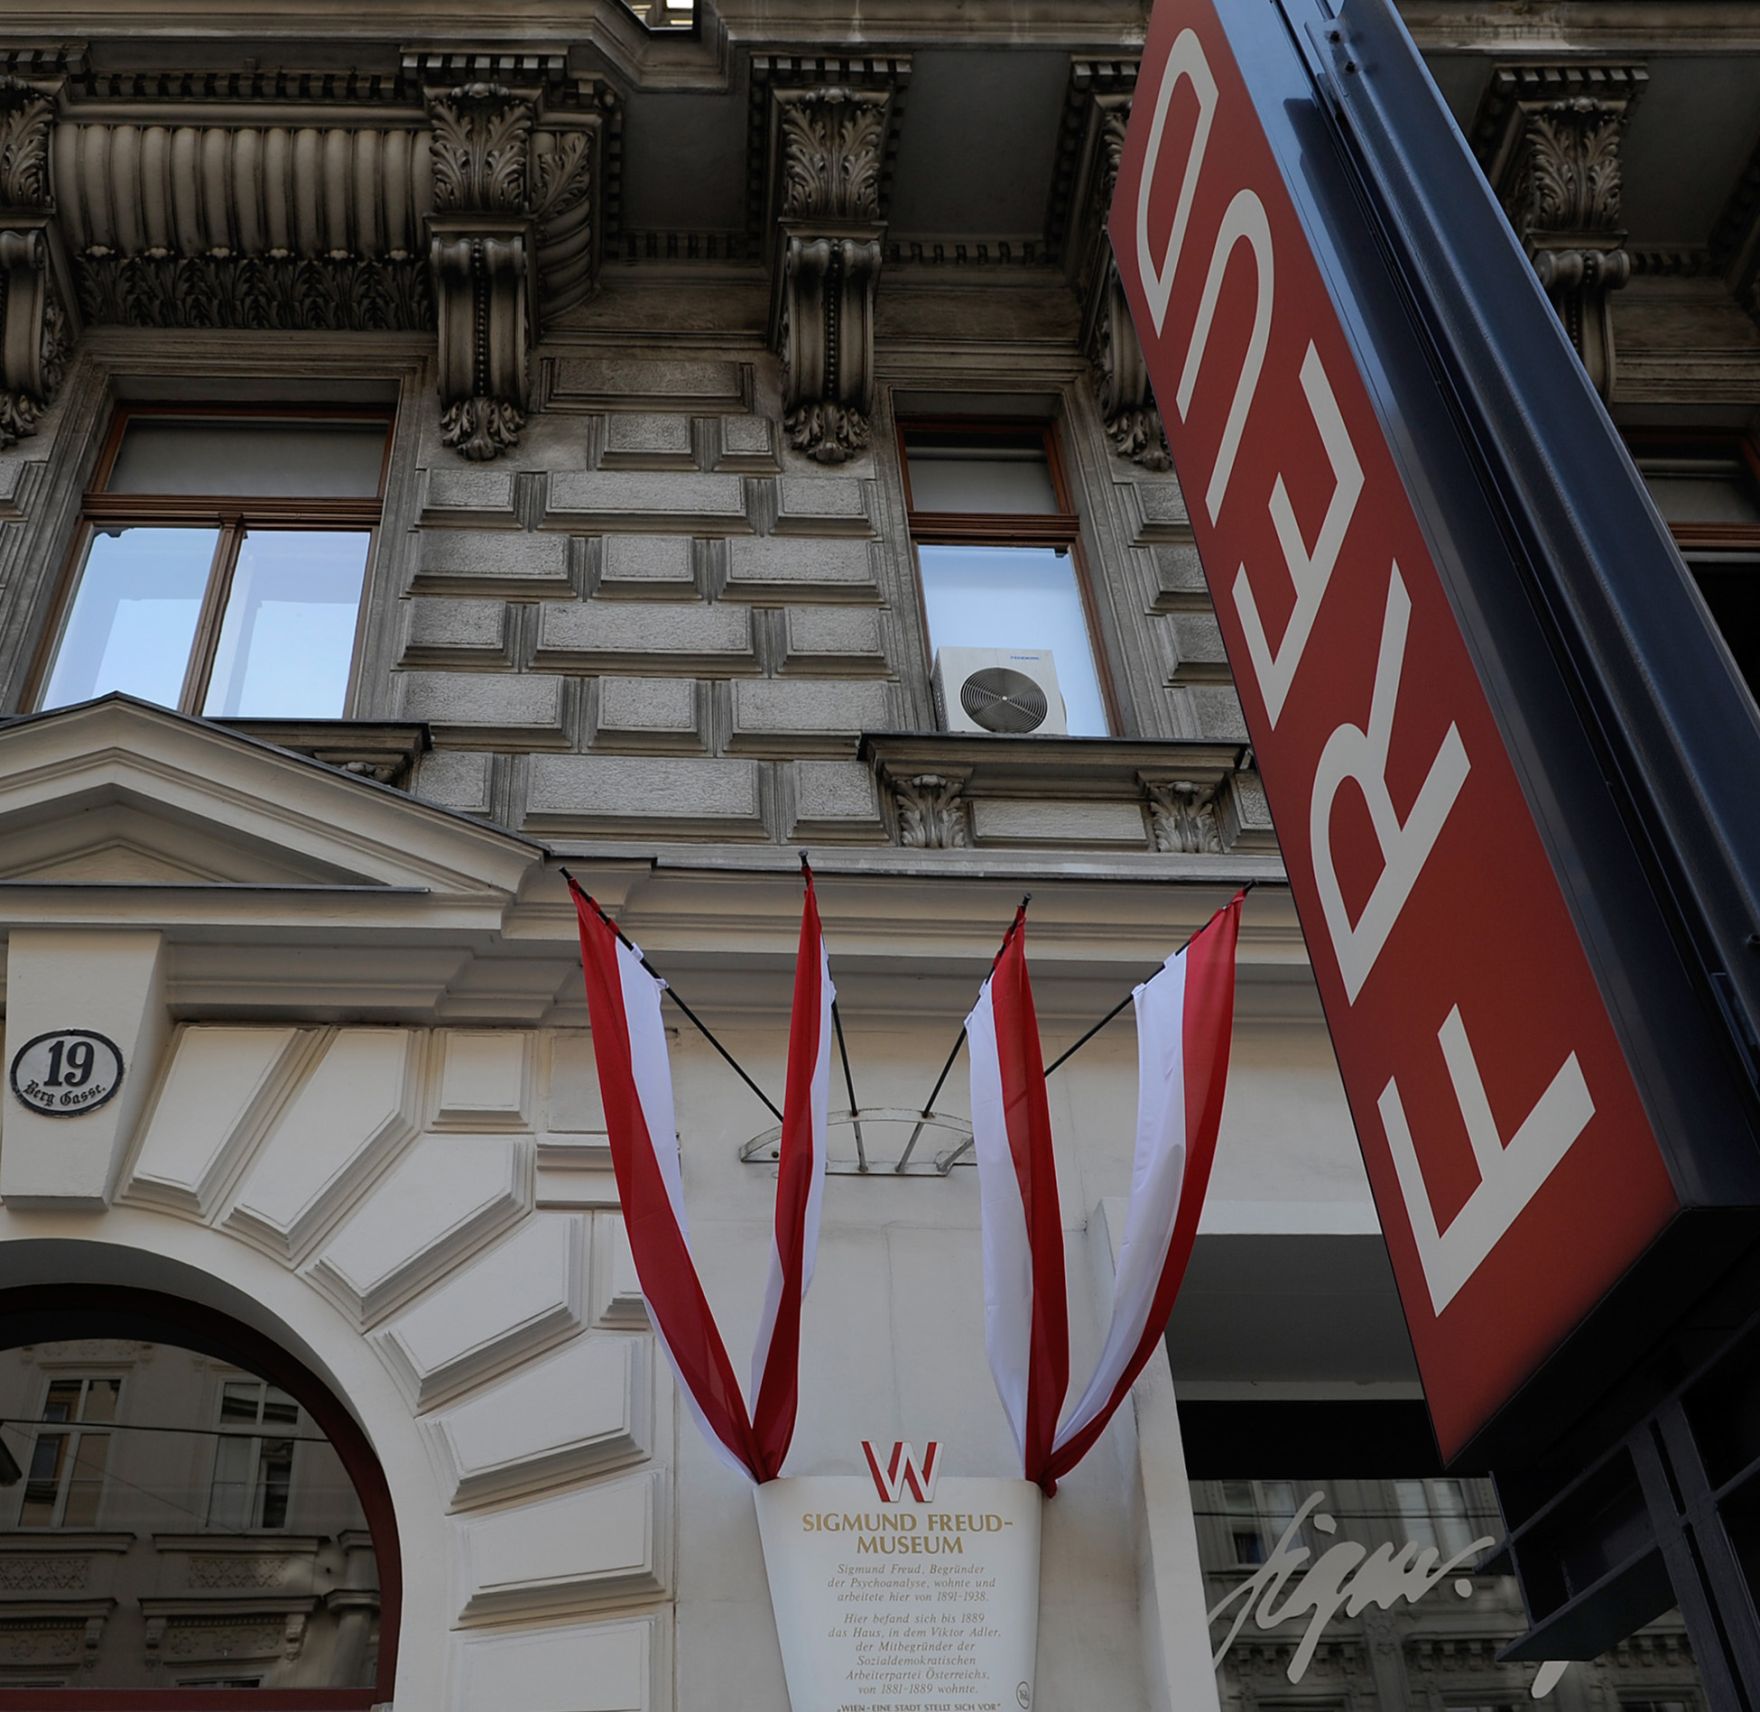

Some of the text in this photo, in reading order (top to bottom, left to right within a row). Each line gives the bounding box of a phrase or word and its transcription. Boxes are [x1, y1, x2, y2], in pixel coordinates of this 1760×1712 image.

[1136, 28, 1596, 1318] FREUD
[43, 1040, 95, 1088] 19
[23, 1079, 56, 1107] Berg
[802, 1513, 1014, 1532] SIGMUND FREUD-
[857, 1535, 964, 1554] MUSEUM
[837, 1563, 886, 1576] Sigmund
[929, 1563, 985, 1576] Begründer
[827, 1577, 846, 1588] der
[934, 1577, 970, 1588] wohnte
[975, 1577, 996, 1588] und
[888, 1592, 911, 1602] hier
[914, 1594, 932, 1602] von
[844, 1612, 985, 1625] Hier befand sich bis 1889
[827, 1627, 848, 1638] das
[888, 1628, 900, 1638] in
[903, 1627, 927, 1638] dem
[931, 1627, 965, 1638] Viktor
[855, 1640, 976, 1653] der Mitbegründer der
[857, 1654, 976, 1666] Sozialdemokratischen
[858, 1686, 876, 1695] von
[881, 1683, 934, 1694] 1881-1889
[894, 1703, 921, 1712] STADT
[924, 1703, 952, 1712] STELLT
[954, 1703, 976, 1712] SICH
